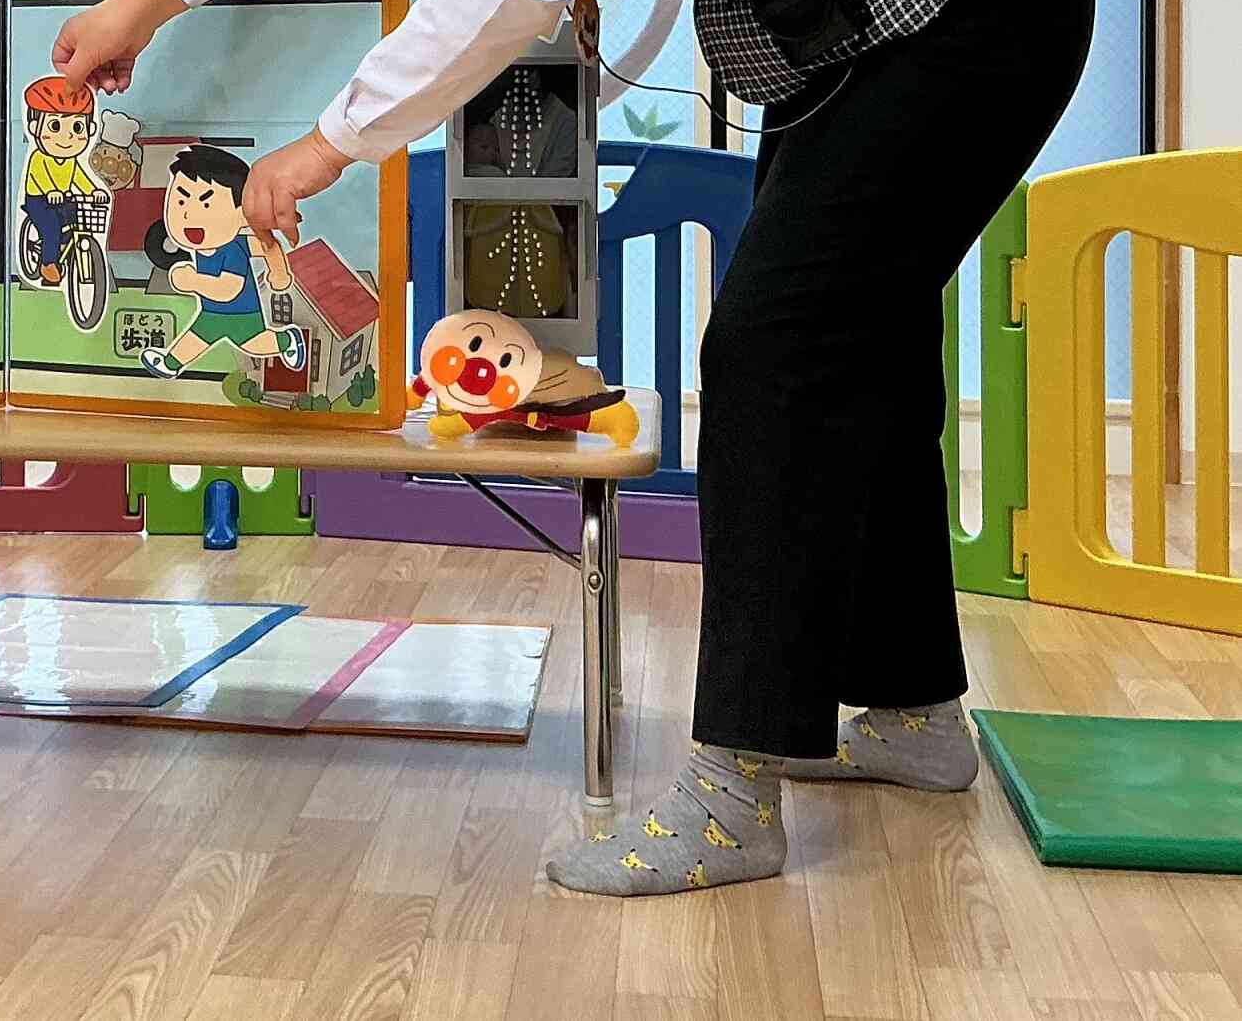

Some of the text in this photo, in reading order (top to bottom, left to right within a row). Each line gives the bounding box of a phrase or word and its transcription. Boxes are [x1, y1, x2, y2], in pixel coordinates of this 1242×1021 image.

[123, 313, 164, 327] ほどう
[121, 327, 166, 351] 歩道
